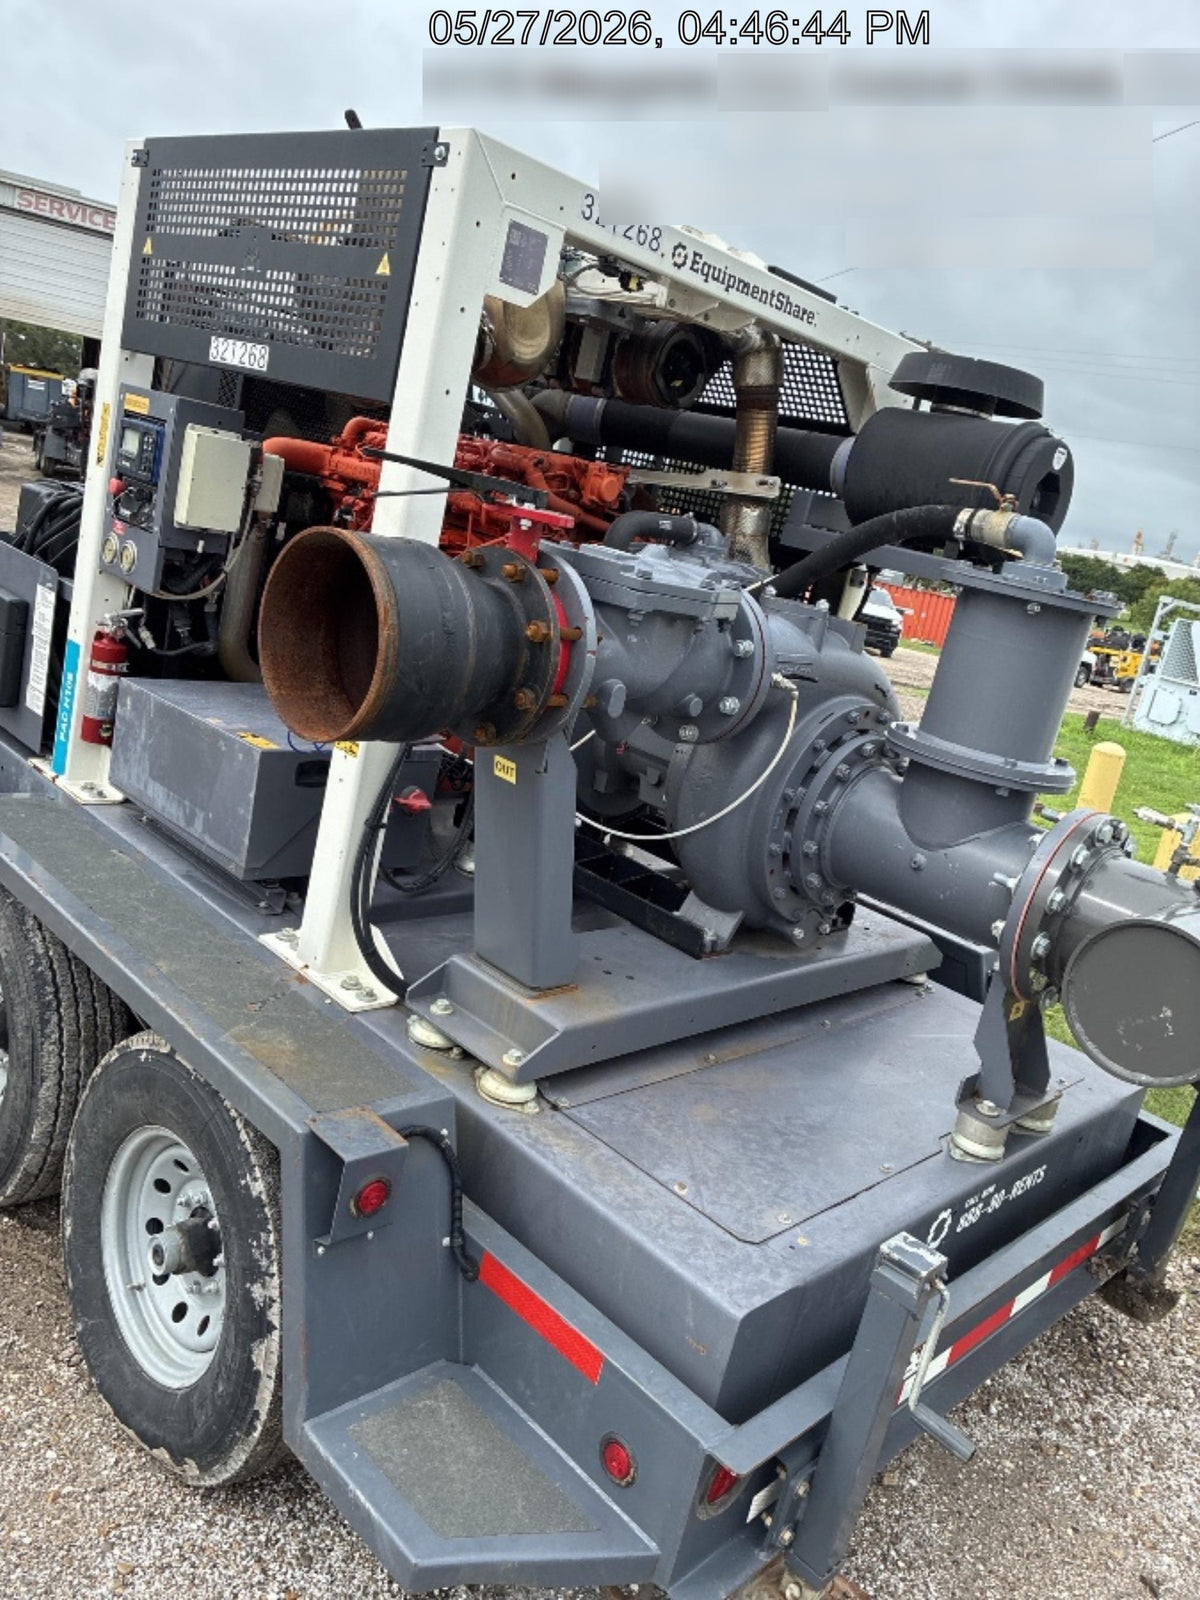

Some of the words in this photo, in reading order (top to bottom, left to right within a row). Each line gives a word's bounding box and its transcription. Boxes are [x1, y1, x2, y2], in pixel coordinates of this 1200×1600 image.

[17, 191, 116, 231] SERVICE
[581, 193, 662, 252] 3268
[690, 250, 816, 326] EquipmentShare
[211, 337, 267, 369] 321268
